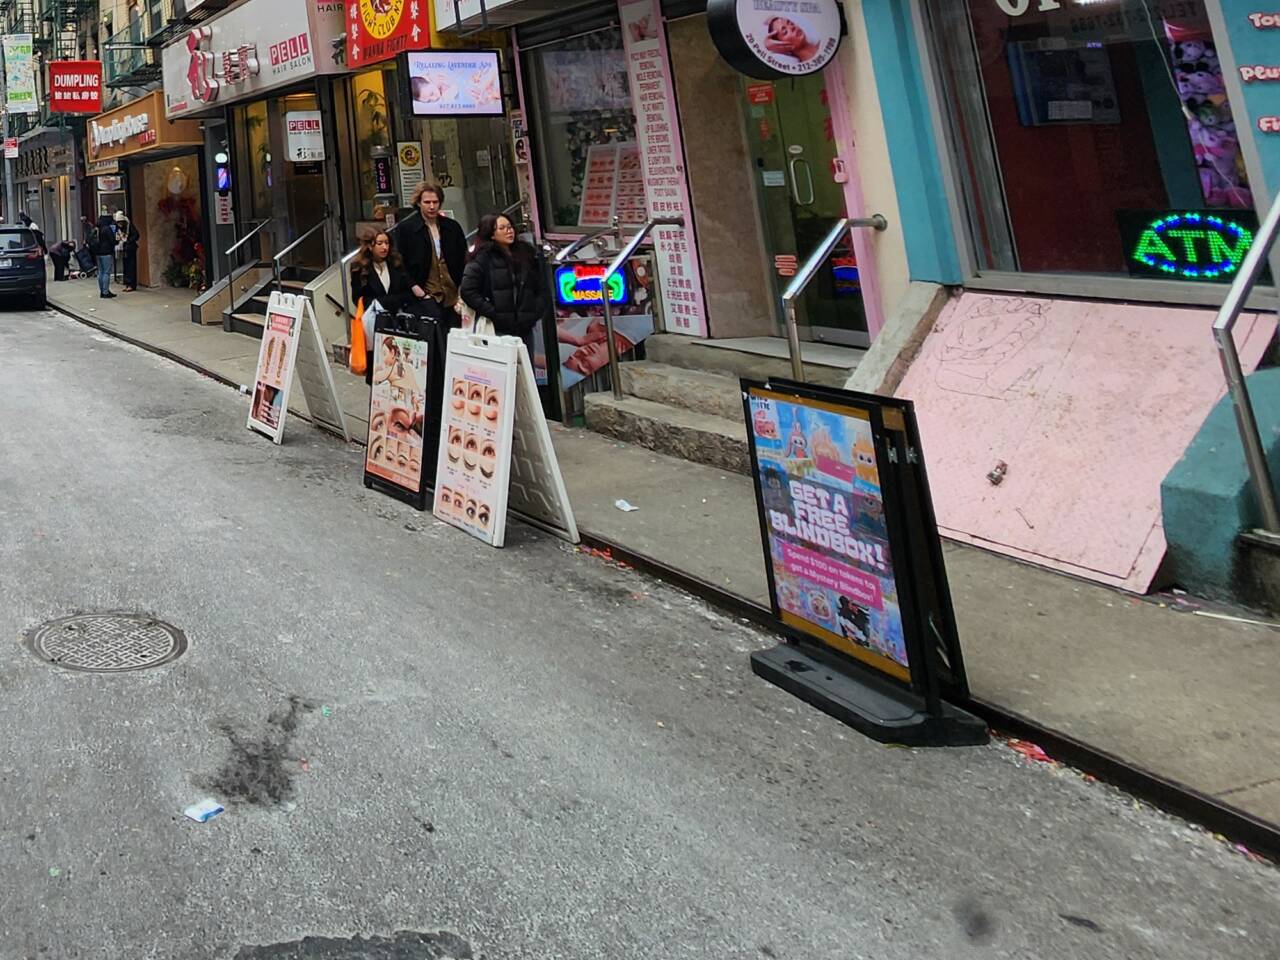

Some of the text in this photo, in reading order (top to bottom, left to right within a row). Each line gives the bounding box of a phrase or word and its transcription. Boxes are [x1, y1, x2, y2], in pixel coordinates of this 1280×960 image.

[317, 4, 343, 12] HAIR
[753, 0, 798, 12] BEAUTY
[377, 16, 395, 36] CLUB
[270, 33, 310, 66] PELL
[753, 44, 767, 58] Pell
[767, 55, 791, 71] Street
[272, 56, 312, 76] HAIR SALON
[54, 74, 98, 87] DUMPLING
[288, 120, 320, 131] PELL
[378, 162, 386, 189] CLUB
[438, 175, 453, 188] 22
[1133, 228, 1254, 264] ATM
[572, 290, 613, 299] MASSAE
[789, 480, 849, 518] GET A
[793, 500, 850, 536] FREE
[769, 509, 886, 570] BLINDBOX!
[787, 548, 809, 563] Spend
[829, 566, 839, 575] on
[839, 569, 864, 586] tokens
